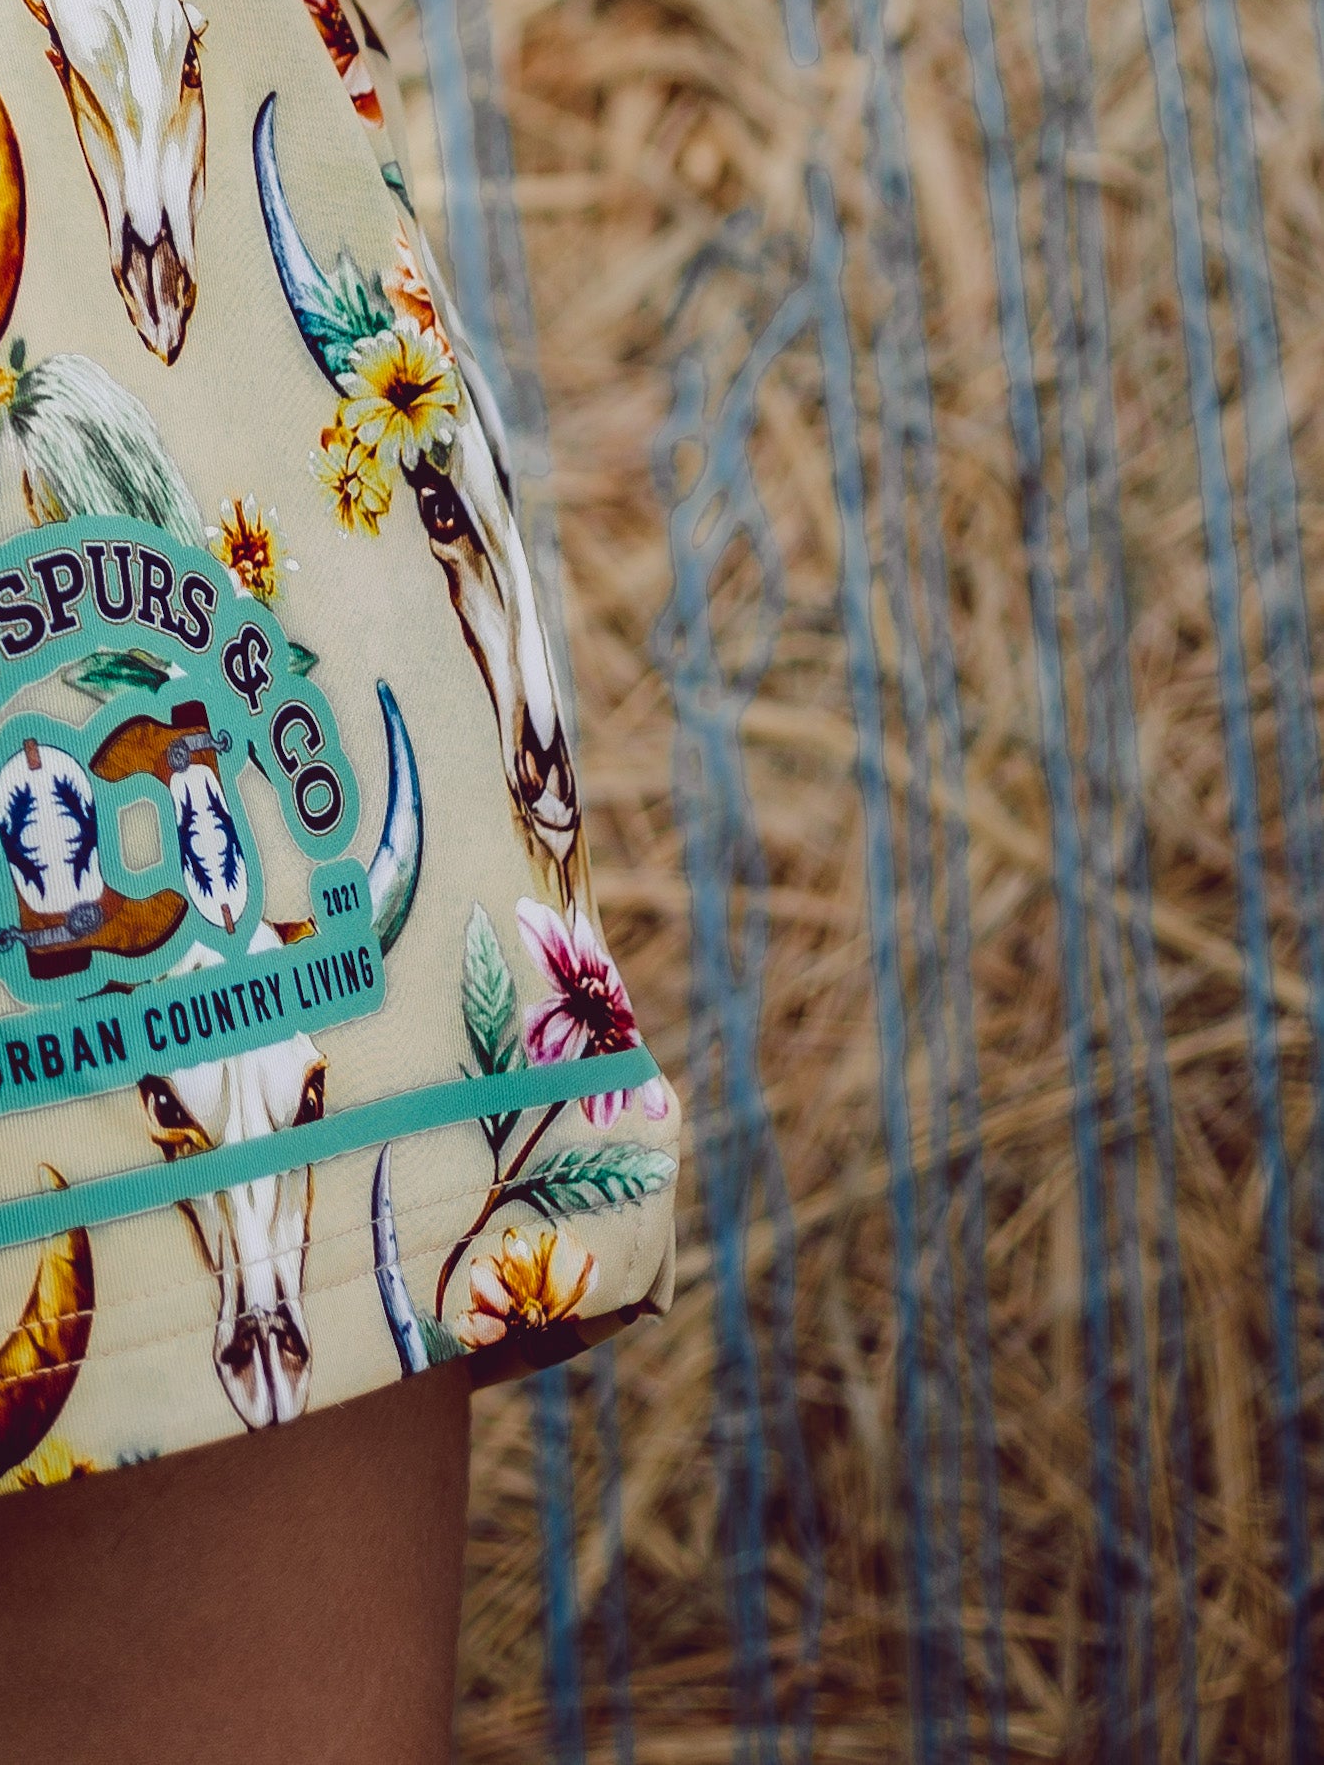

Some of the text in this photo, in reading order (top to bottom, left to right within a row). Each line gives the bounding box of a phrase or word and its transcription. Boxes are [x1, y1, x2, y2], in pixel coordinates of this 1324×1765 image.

[221, 623, 272, 715] &
[270, 700, 345, 836] CO
[323, 882, 360, 916] 2021
[144, 973, 284, 1053] COUNTRY
[297, 946, 374, 1009] LIVING
